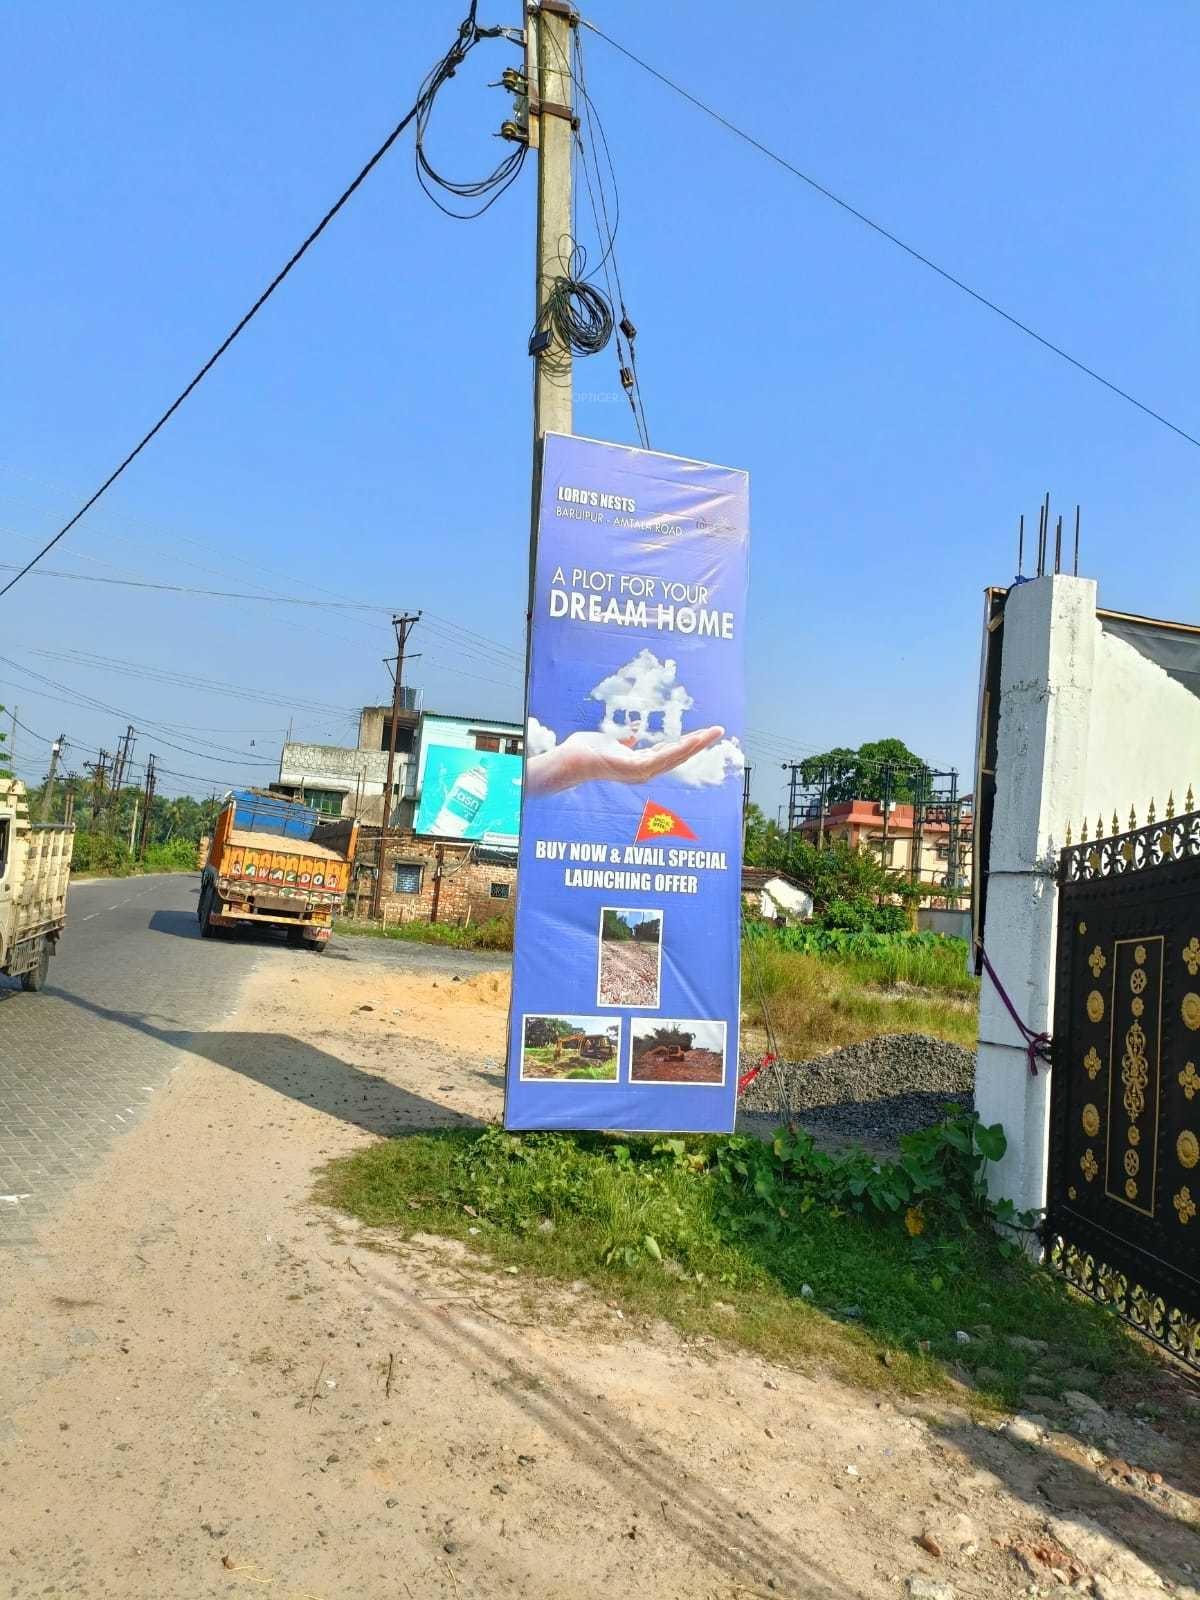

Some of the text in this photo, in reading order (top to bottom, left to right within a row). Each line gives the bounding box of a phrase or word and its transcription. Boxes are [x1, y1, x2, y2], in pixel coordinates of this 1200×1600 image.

[557, 486, 636, 513] LORD'S NESTS
[655, 523, 684, 537] ROAD
[552, 566, 709, 605] A PLOT FOR YOUR
[549, 588, 734, 639] DREAM HOME
[535, 840, 727, 870] BUY NOW & AVAIL SPECIAL
[565, 868, 699, 894] LAUNCHING OFFER
